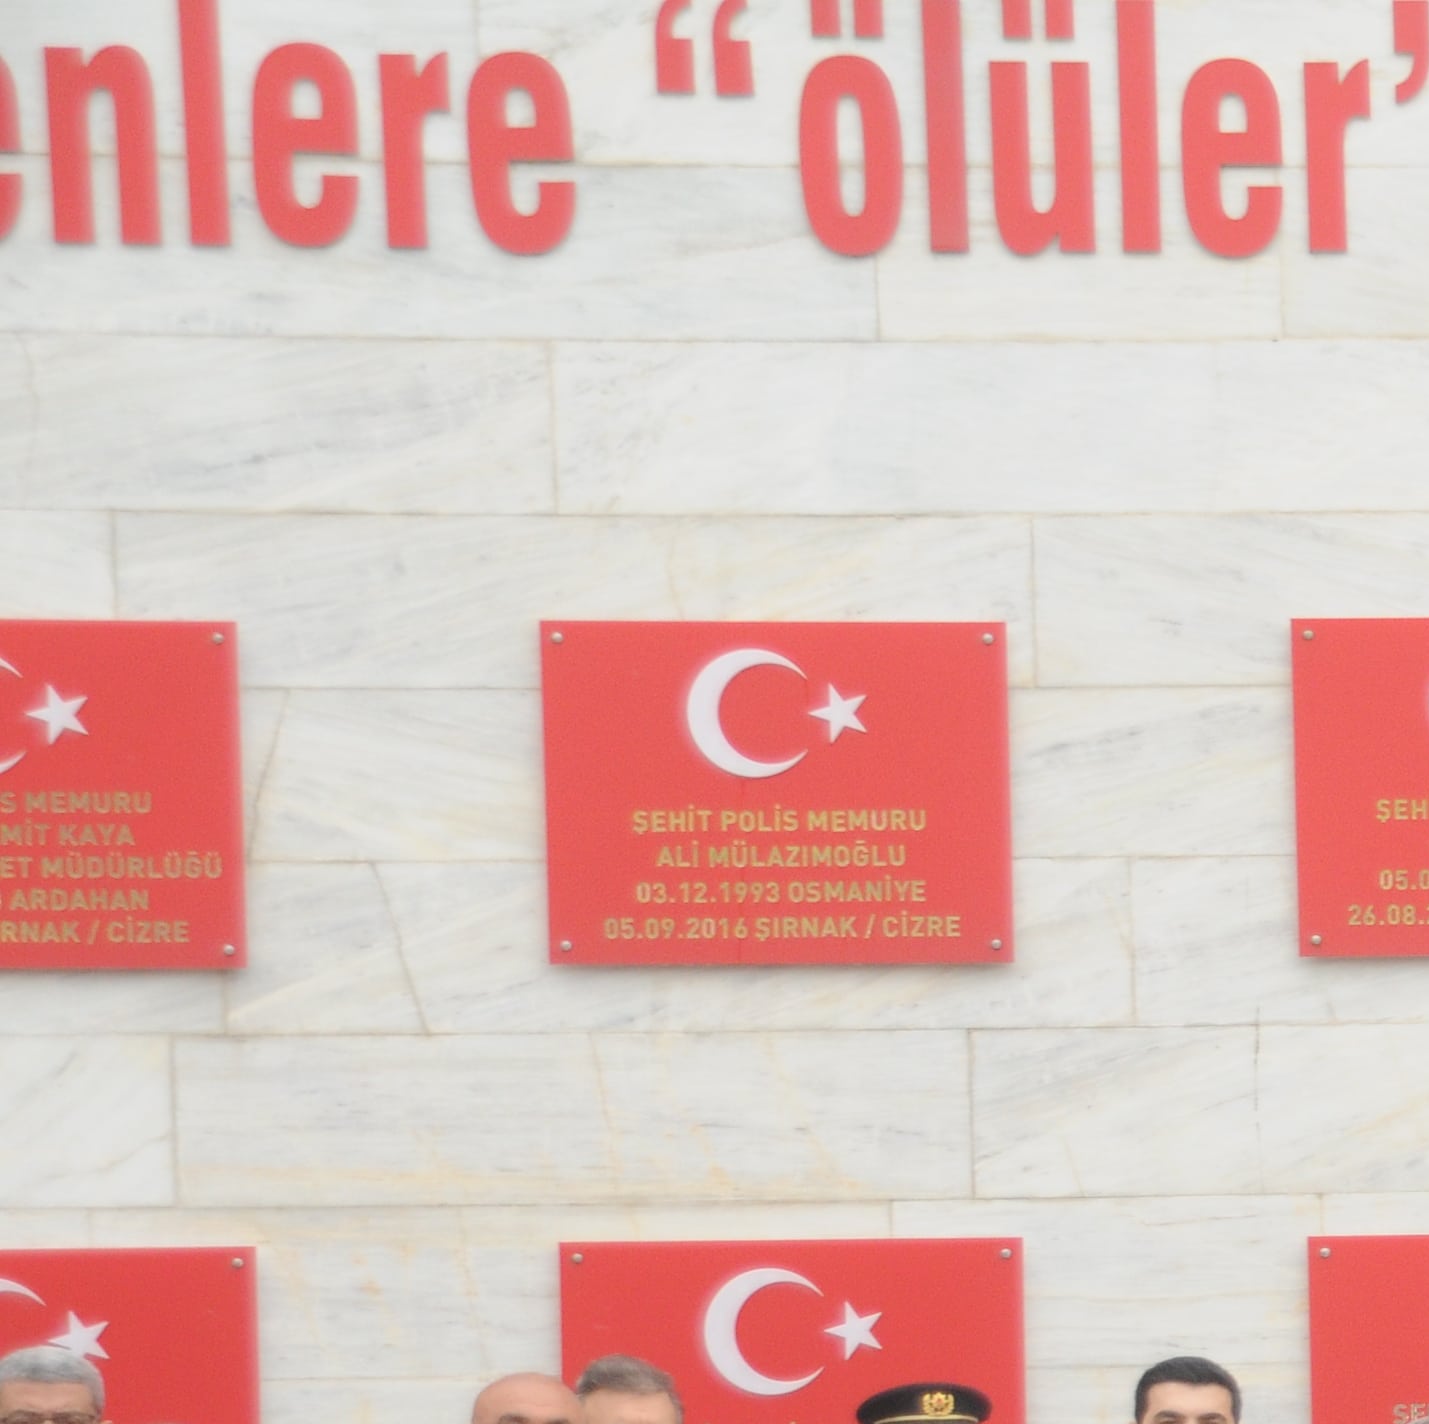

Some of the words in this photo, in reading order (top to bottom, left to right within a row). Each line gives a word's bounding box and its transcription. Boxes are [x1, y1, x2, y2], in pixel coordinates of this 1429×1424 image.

[0, 0, 577, 258] nlere
[24, 791, 151, 814] MEMURU
[632, 804, 713, 834] ŞEHİT
[719, 805, 800, 833] POLİS
[806, 808, 926, 832] MEMURU
[58, 824, 134, 846] KAYA
[40, 850, 222, 879] MÜDÜRLÜĞÜ
[656, 840, 700, 868] ALİ
[707, 839, 906, 868] MÜLAZIMOĞLU
[9, 888, 149, 911] ARDAHAN
[635, 881, 781, 904] 03.12.1993
[787, 875, 926, 903] OSMANİYE
[105, 916, 189, 944] CİZRE
[603, 917, 750, 940] 05.09.2016
[754, 916, 858, 941] ŞIRNAK
[864, 913, 874, 940] /
[881, 910, 961, 938] CİZRE
